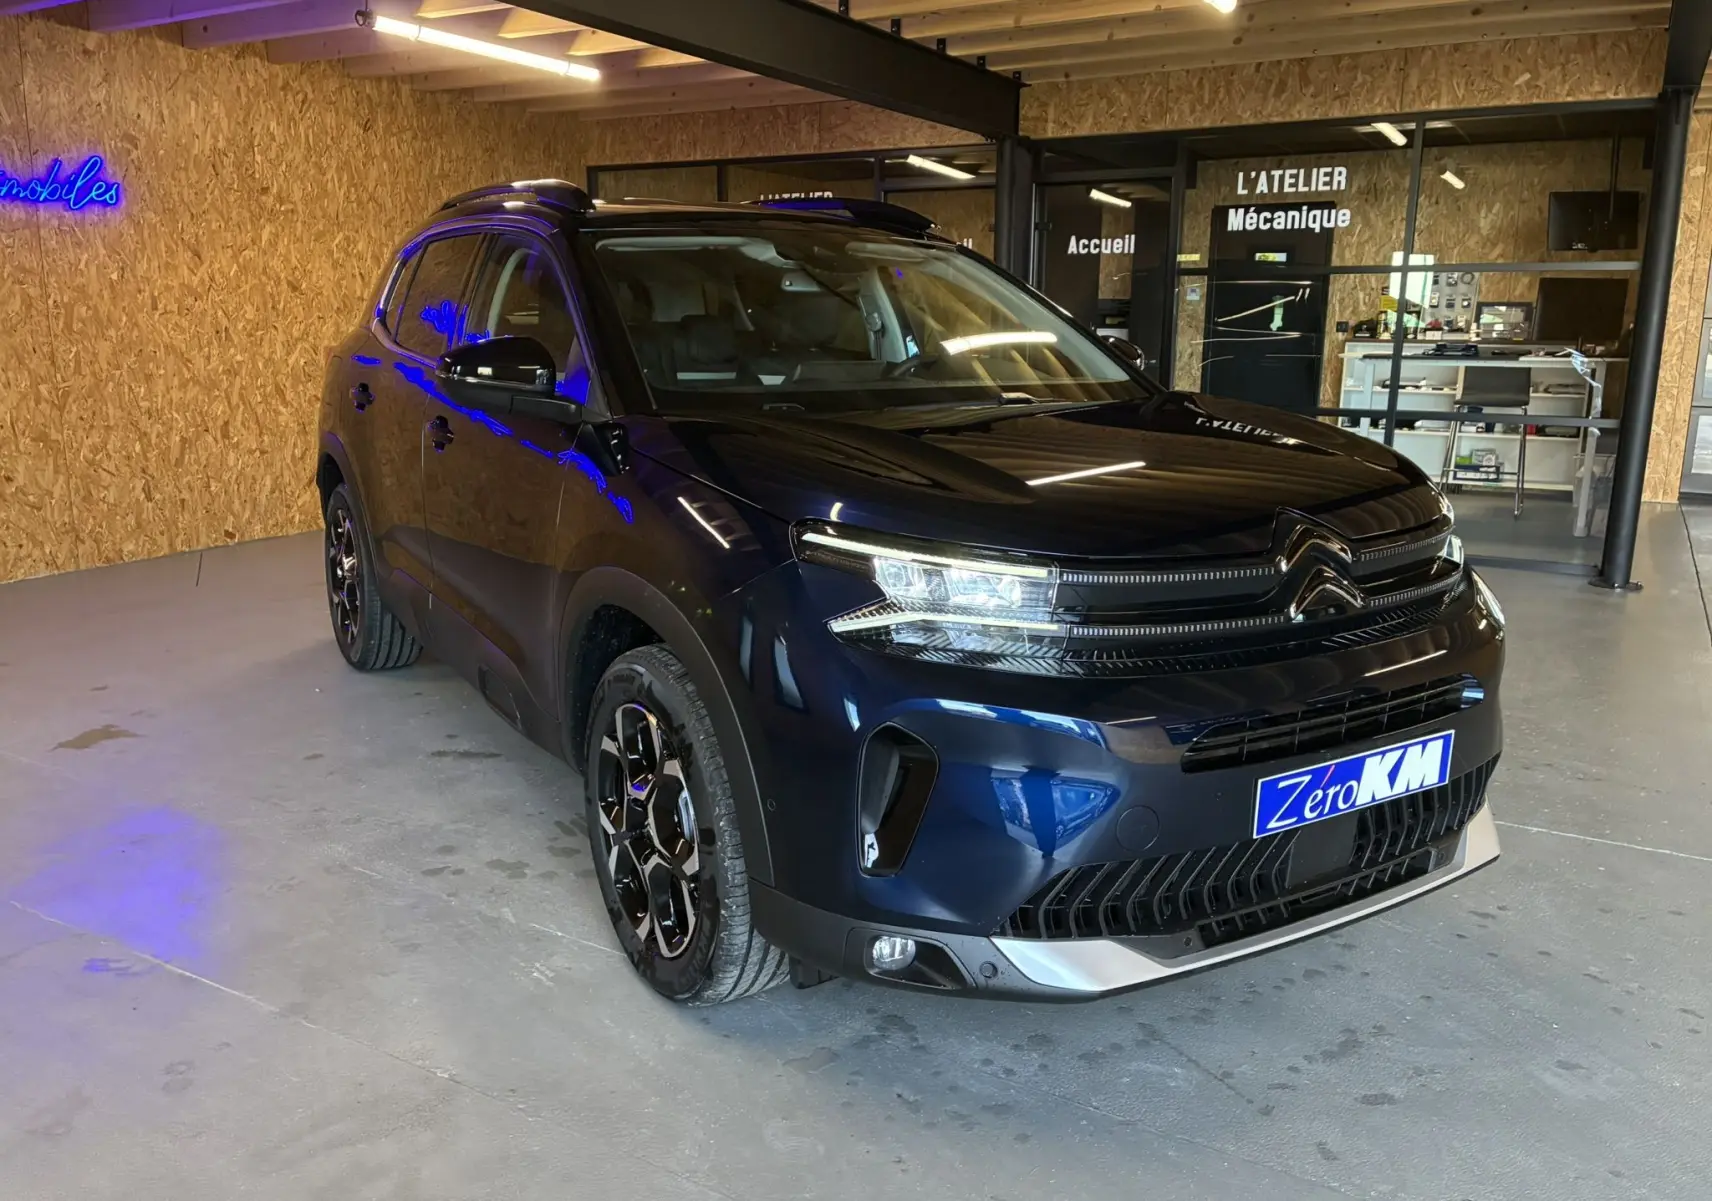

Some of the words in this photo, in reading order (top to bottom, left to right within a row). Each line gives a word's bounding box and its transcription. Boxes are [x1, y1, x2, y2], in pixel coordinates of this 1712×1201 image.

[0, 156, 119, 209] mobiles
[1237, 166, 1347, 195] L'ATELIER
[1227, 206, 1351, 233] Mécanique
[1067, 235, 1136, 254] Accueil
